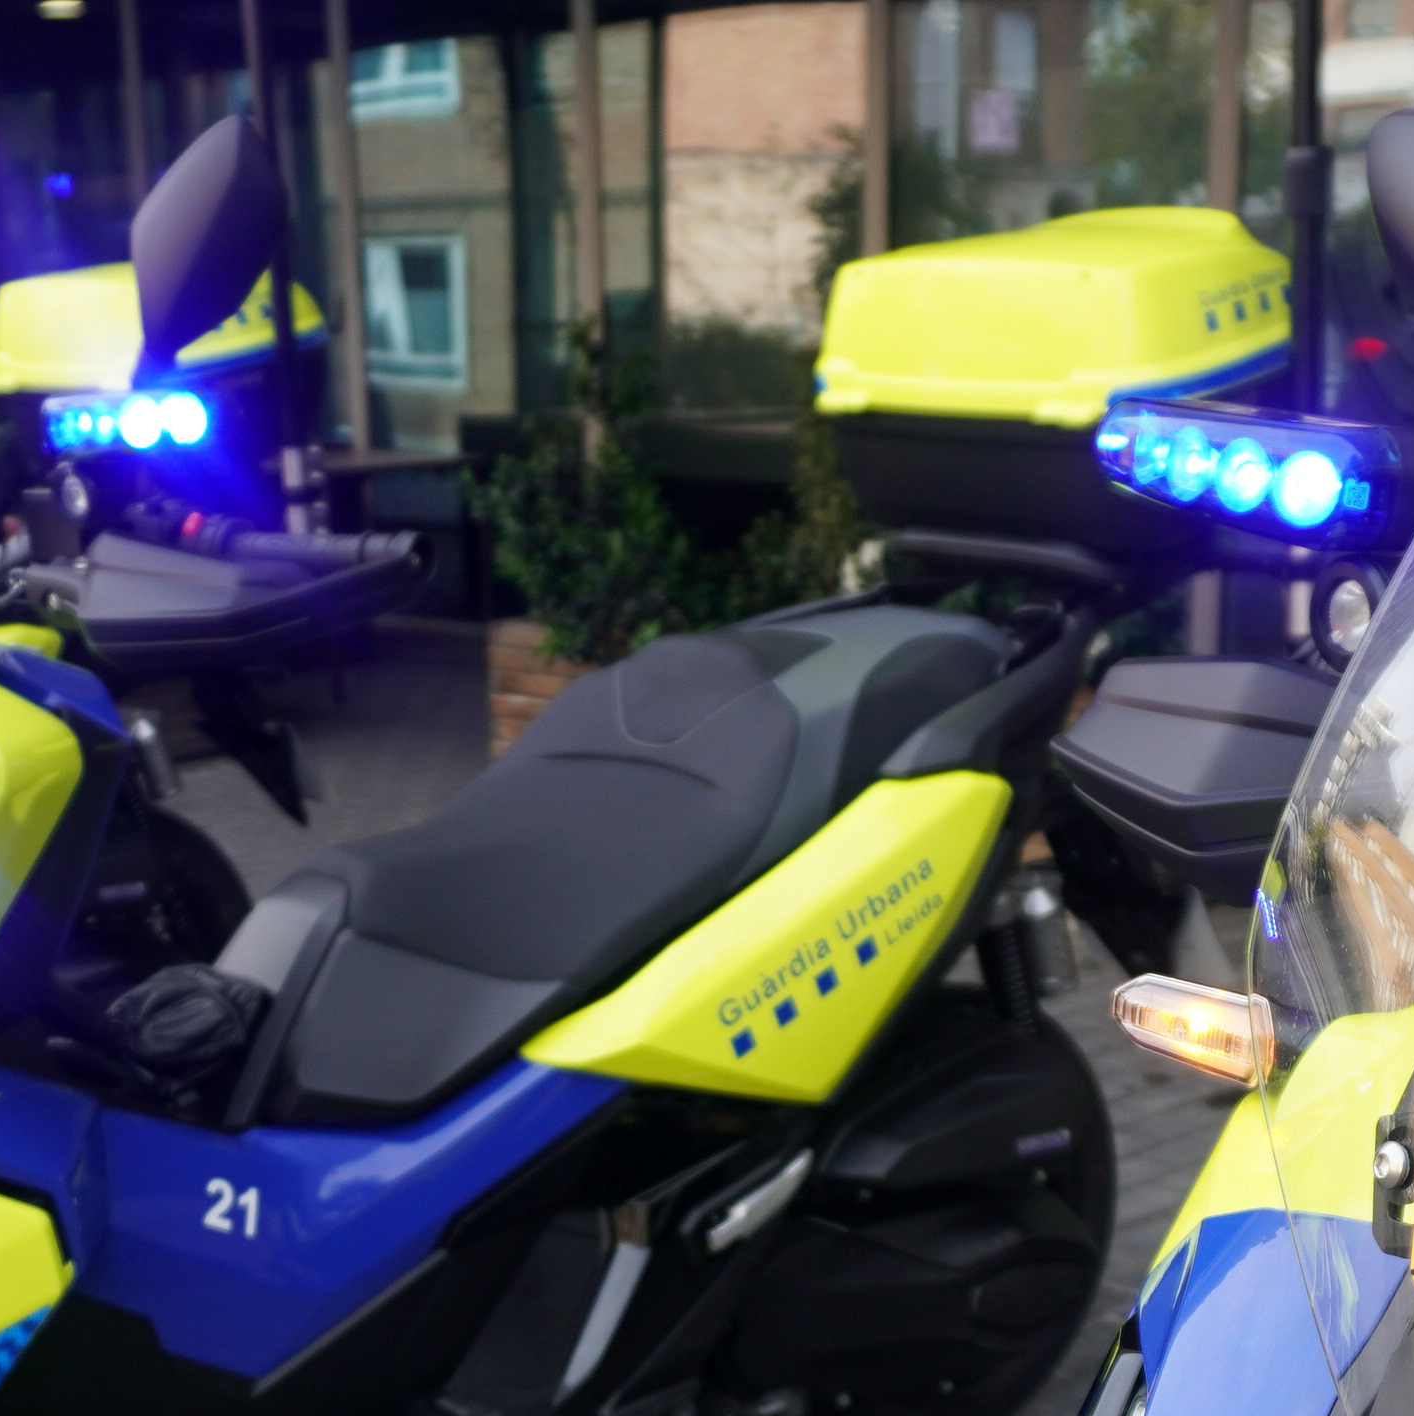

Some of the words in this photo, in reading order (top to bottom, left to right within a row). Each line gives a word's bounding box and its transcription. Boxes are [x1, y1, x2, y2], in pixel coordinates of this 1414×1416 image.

[718, 937, 831, 1027] Guàrdia
[835, 858, 935, 941] Urbana
[884, 892, 945, 945] Lleida
[203, 1177, 259, 1238] 21
